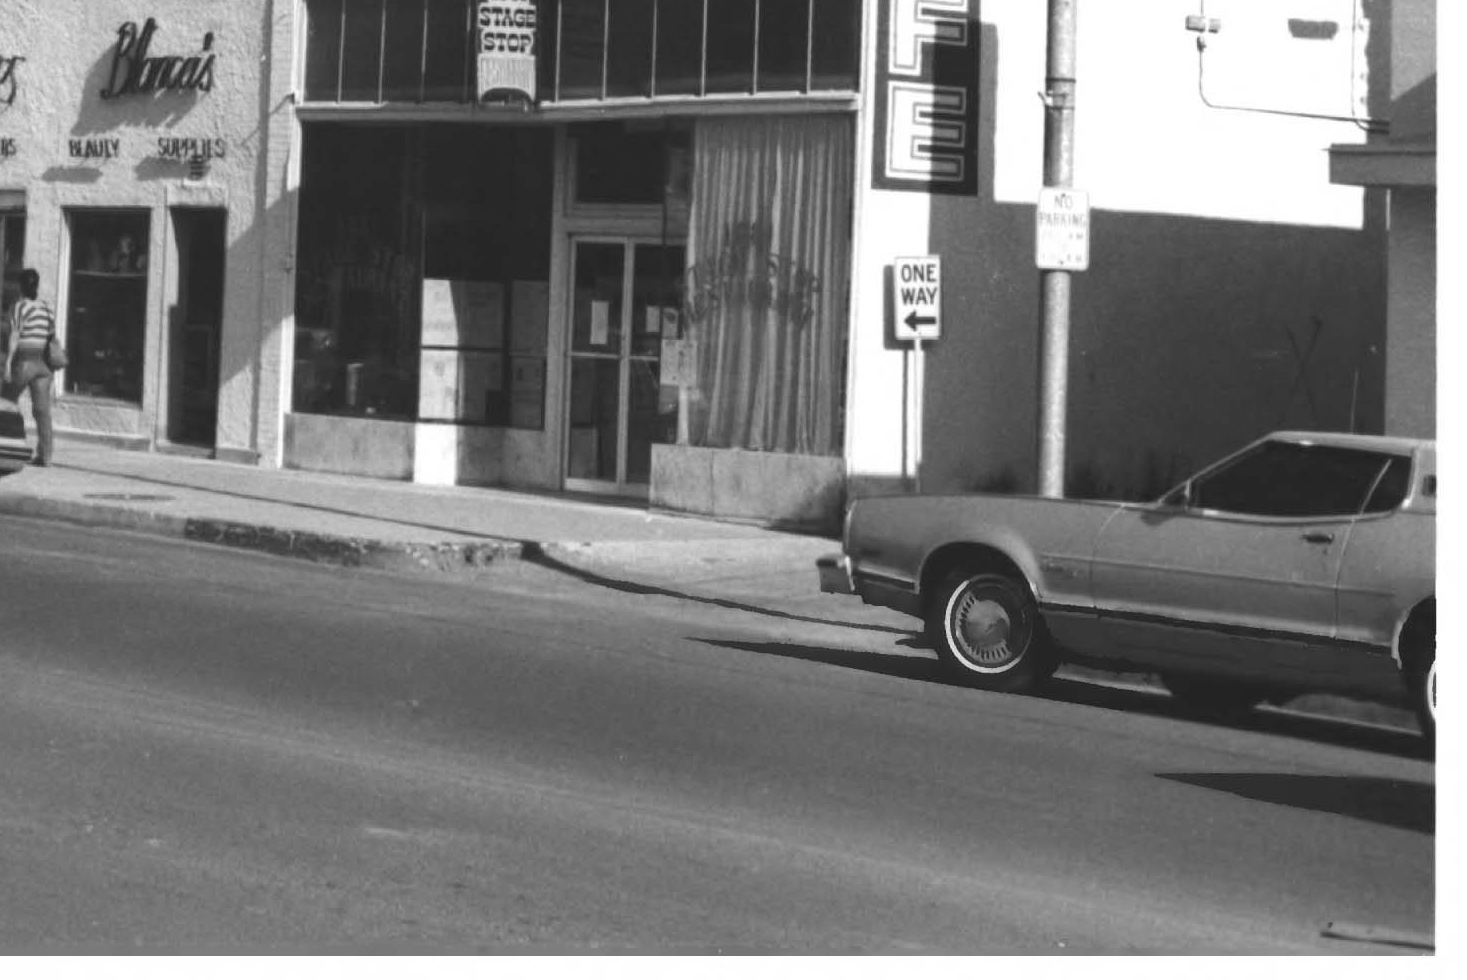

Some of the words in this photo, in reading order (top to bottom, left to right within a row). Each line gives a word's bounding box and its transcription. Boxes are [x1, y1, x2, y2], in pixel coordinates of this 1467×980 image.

[480, 6, 536, 28] STAGE
[484, 32, 532, 53] STOP
[100, 17, 216, 101] Blanca's
[69, 138, 119, 158] BEAUTY
[158, 136, 227, 159] SUPPLIES
[1054, 195, 1074, 210] NO
[1037, 212, 1087, 228] PARKING
[901, 263, 937, 283] ONE
[901, 287, 938, 306] WAY
